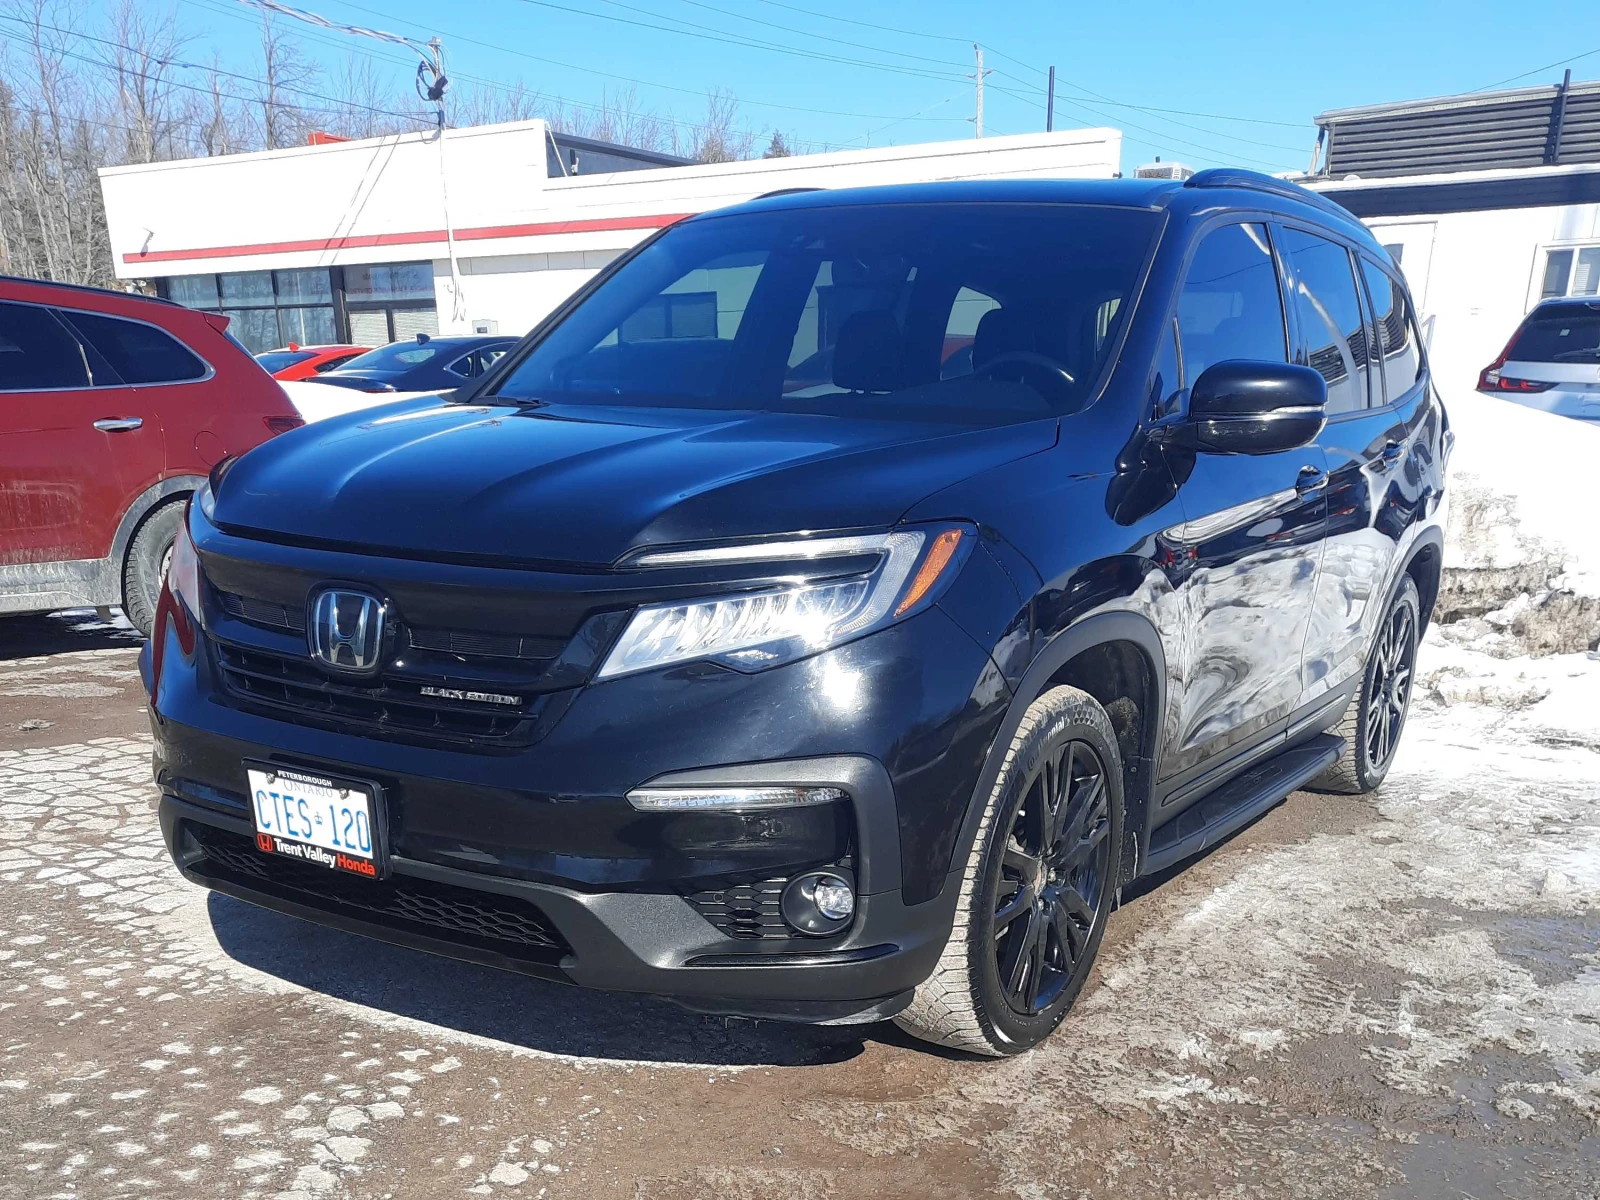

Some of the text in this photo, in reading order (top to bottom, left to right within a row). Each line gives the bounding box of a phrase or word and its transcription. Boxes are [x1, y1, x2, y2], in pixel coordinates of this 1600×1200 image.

[420, 686, 521, 705] BLACK EDITION
[277, 769, 333, 787] PETERBOROUGH
[283, 780, 333, 798] ONTARIO
[256, 790, 372, 853] CTES 120
[274, 838, 303, 857] Trent
[302, 844, 337, 868] Valley
[337, 853, 376, 875] Honda
